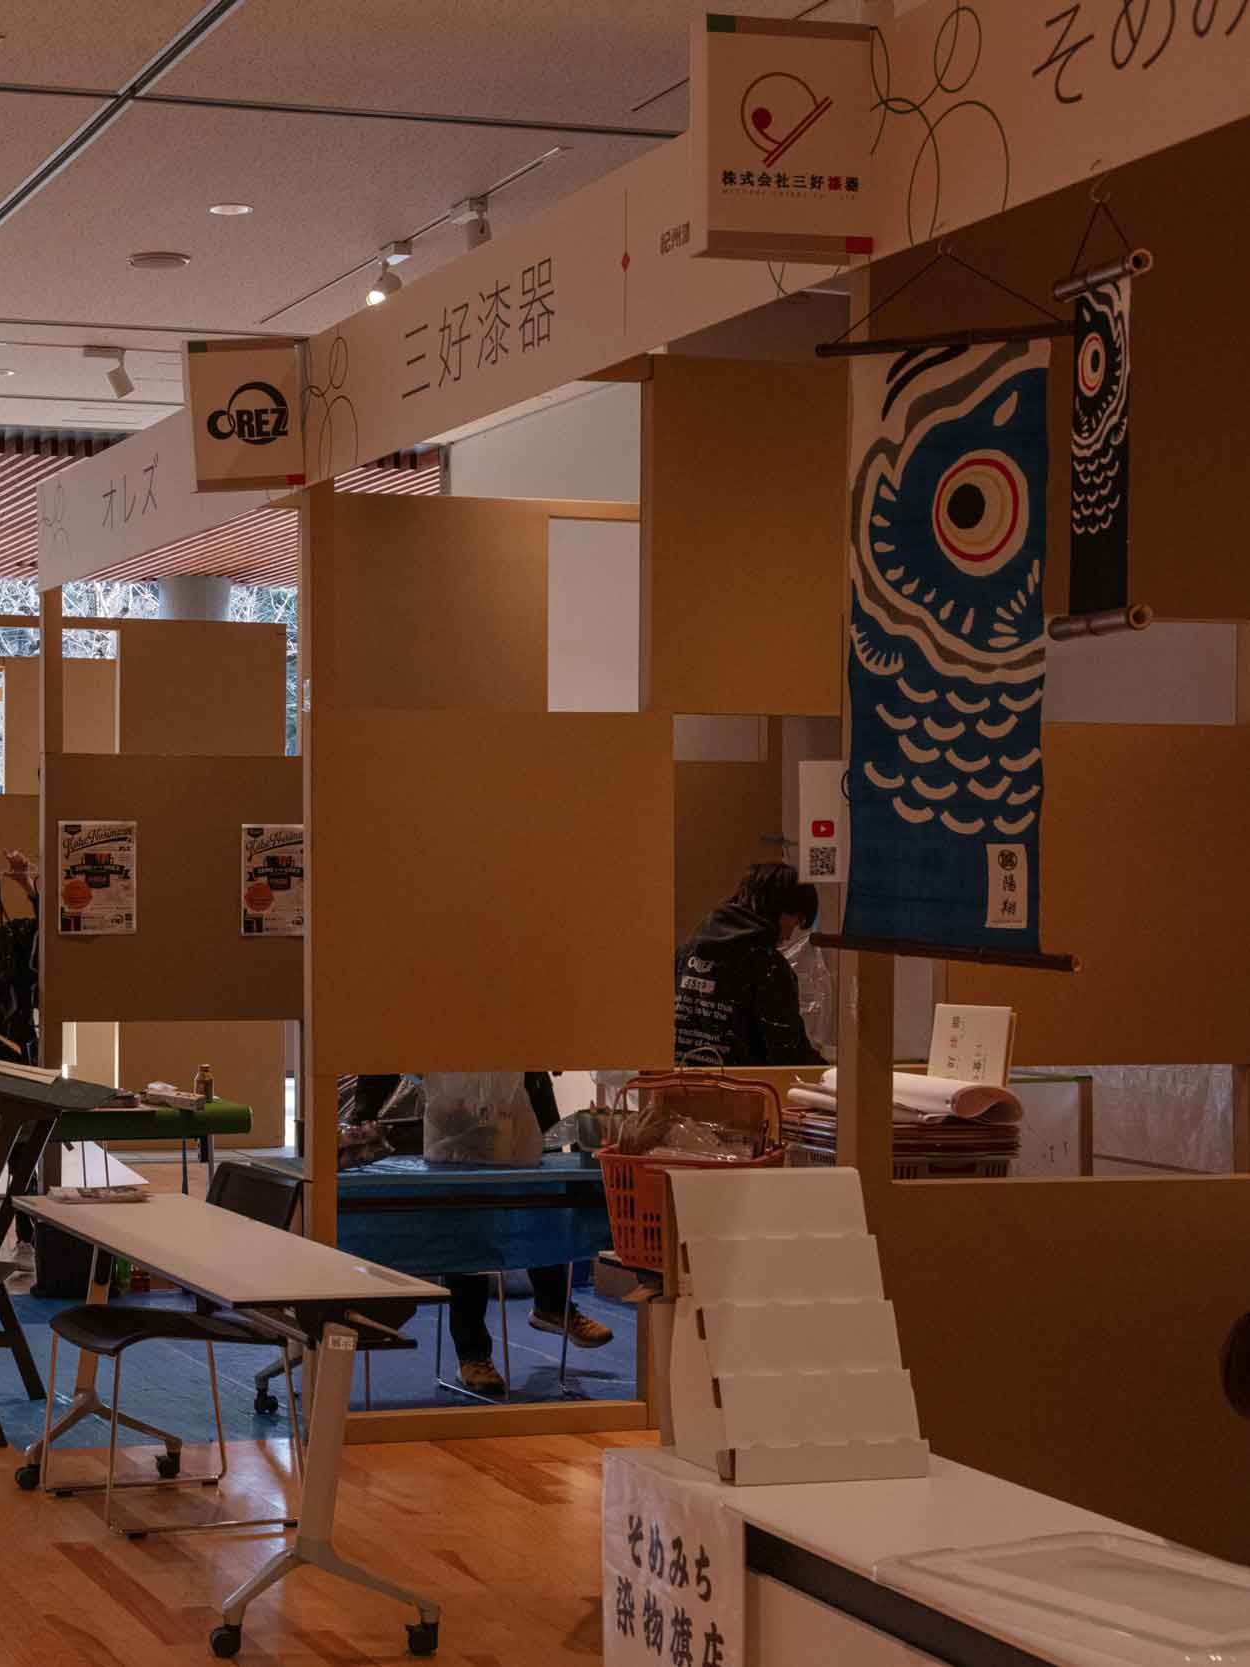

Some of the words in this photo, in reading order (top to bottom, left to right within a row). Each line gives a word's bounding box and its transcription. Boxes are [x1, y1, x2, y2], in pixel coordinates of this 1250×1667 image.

[402, 256, 555, 400] 三好漆器
[207, 381, 289, 446] OREZ
[101, 452, 159, 529] オレズ
[627, 1514, 712, 1602] そめみち
[616, 1575, 725, 1667] 染物旗店
